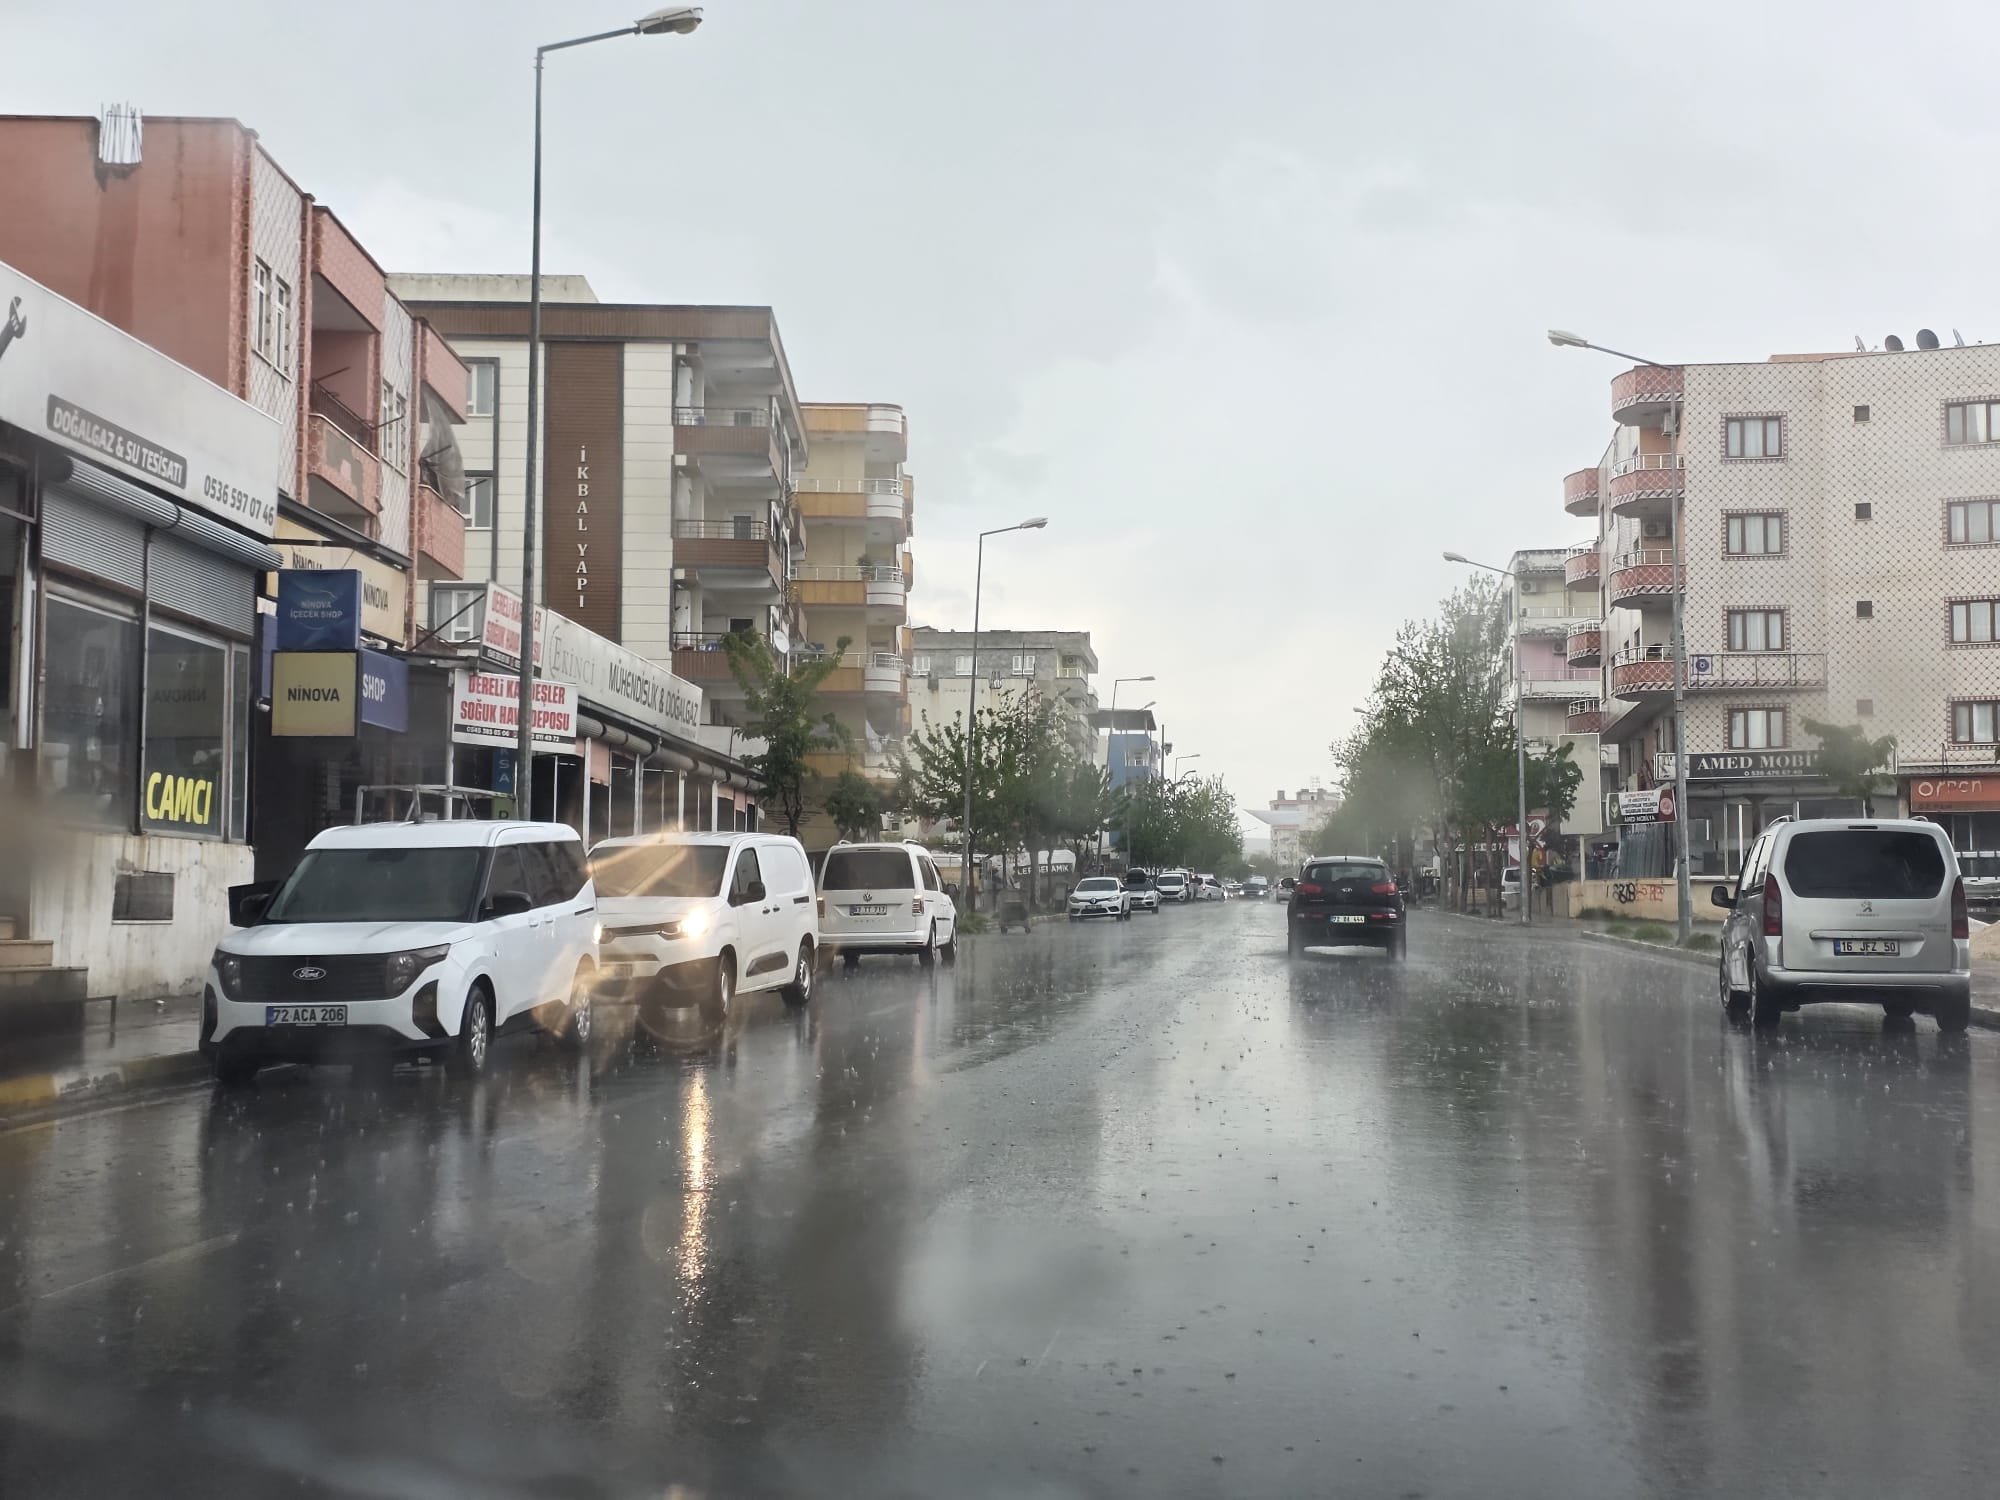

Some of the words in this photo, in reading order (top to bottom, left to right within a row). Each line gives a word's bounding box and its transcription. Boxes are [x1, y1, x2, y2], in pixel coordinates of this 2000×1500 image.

[53, 407, 114, 452] DOĞALGAZ
[116, 437, 124, 457] &
[125, 440, 140, 465] SU
[203, 475, 229, 504] 0536
[230, 487, 249, 512] 597
[250, 496, 262, 520] 07
[262, 505, 274, 526] 46
[576, 543, 588, 608] YAPI
[287, 685, 340, 702] NİNOVA
[363, 673, 386, 702] SHOP
[507, 680, 566, 706] KAEŞLER
[460, 698, 497, 724] SOĞUK
[500, 705, 519, 726] HAV
[532, 710, 570, 731] DEPOSU
[665, 689, 699, 727] DOĞALGAZ
[1697, 755, 1752, 770] AMED
[147, 772, 212, 825] CAMCI
[1842, 941, 1852, 951] 16
[1860, 941, 1877, 951] JFZ
[1884, 942, 1895, 951] 50
[273, 1008, 289, 1022] 72
[293, 1008, 317, 1022] ACA
[321, 1008, 344, 1022] 206
